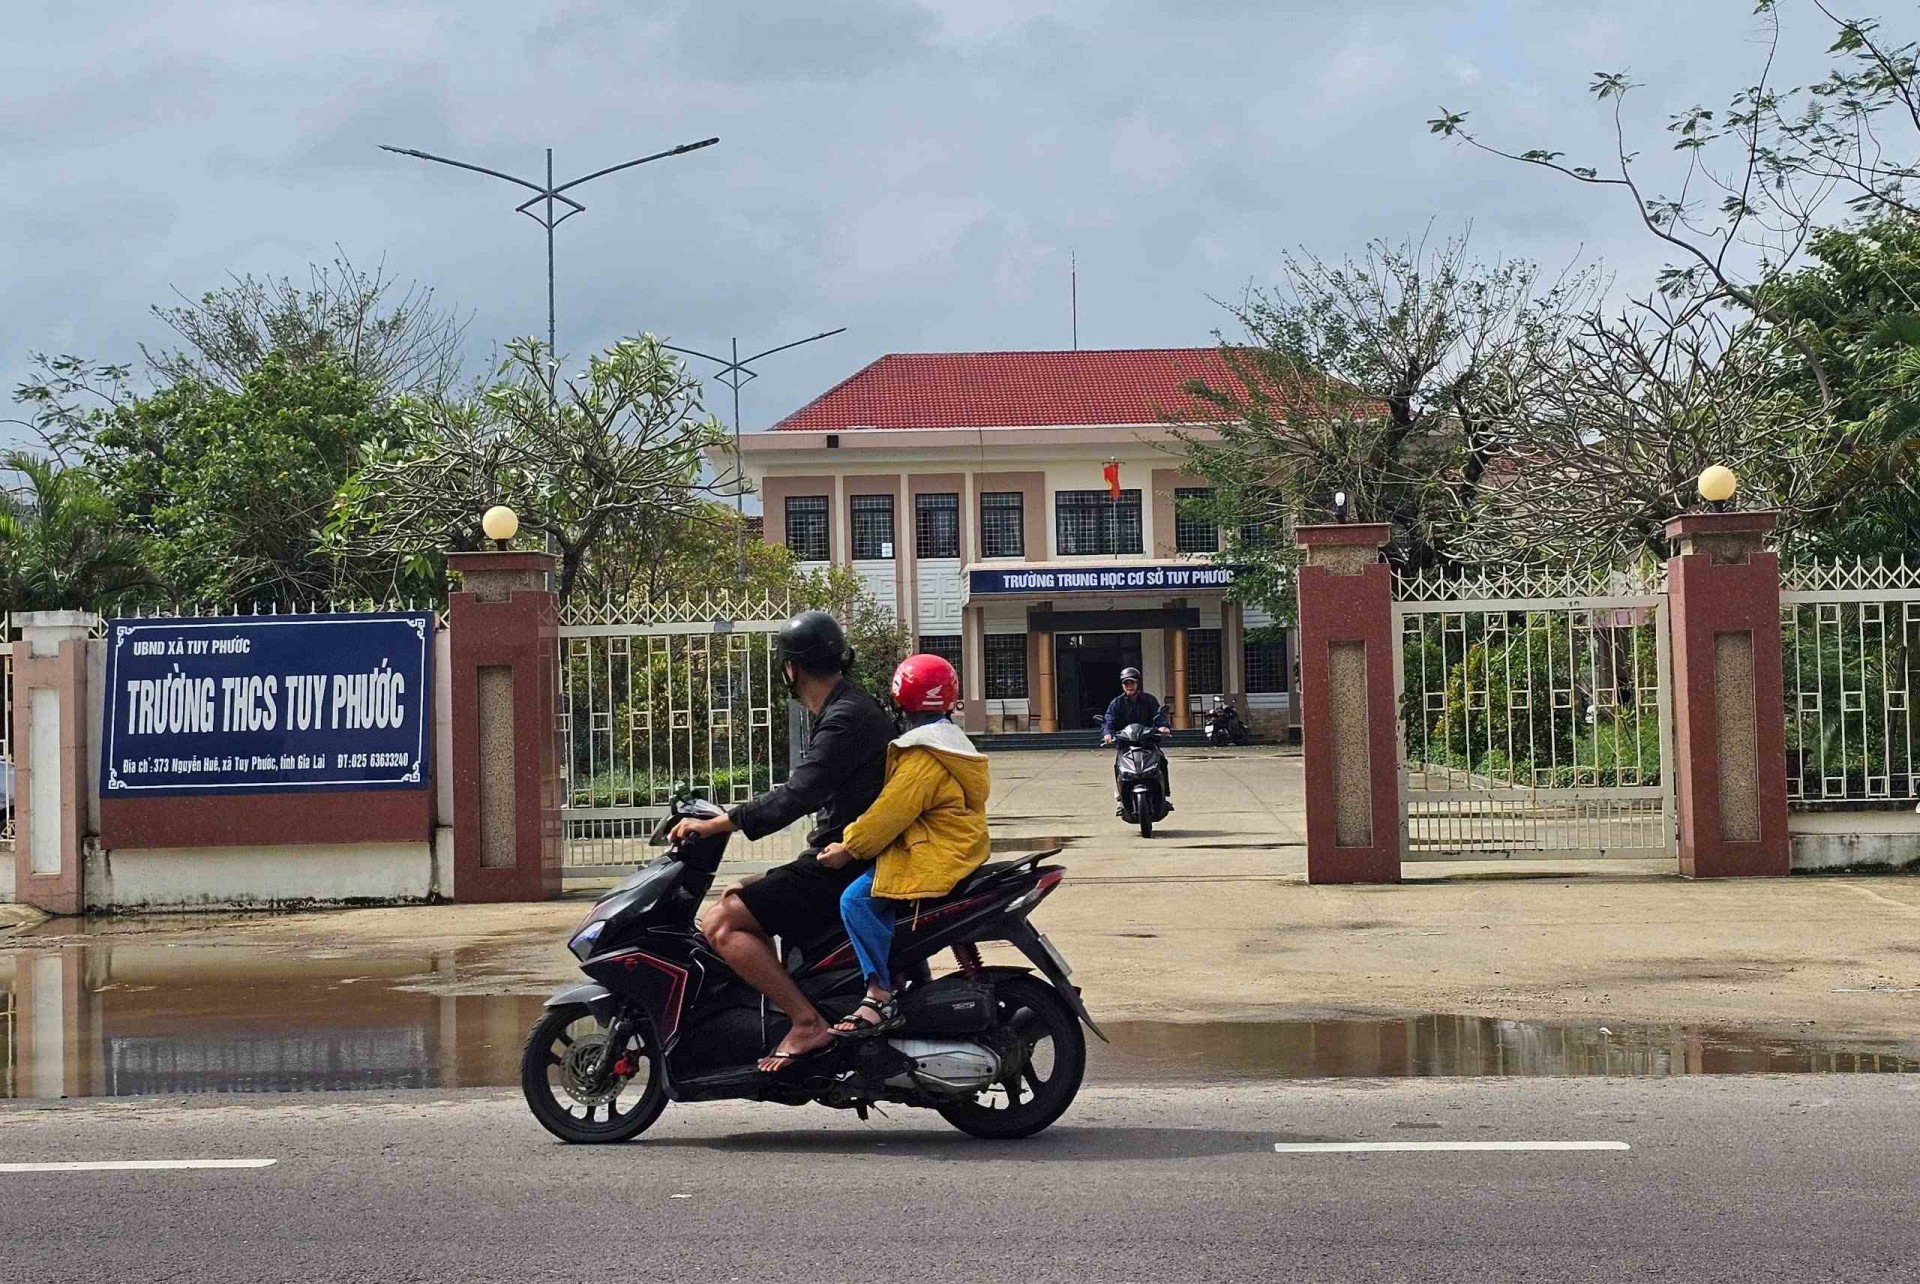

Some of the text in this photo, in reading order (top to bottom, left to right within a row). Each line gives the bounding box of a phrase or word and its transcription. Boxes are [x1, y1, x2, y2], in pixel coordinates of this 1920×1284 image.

[1003, 566, 1235, 589] TRƯỜNG TRUNG HỌC CƠ SỞ TUY PHƯỚC
[133, 634, 250, 656] UBND XÃ TUY PHƯỚC
[127, 657, 405, 734] TRƯỜNG THCS TUY PHƯỚC
[171, 754, 202, 774] Nguyễn
[222, 755, 232, 772] xã
[234, 756, 249, 773] Tuy
[297, 753, 311, 770] Gia
[312, 753, 326, 769] Lai
